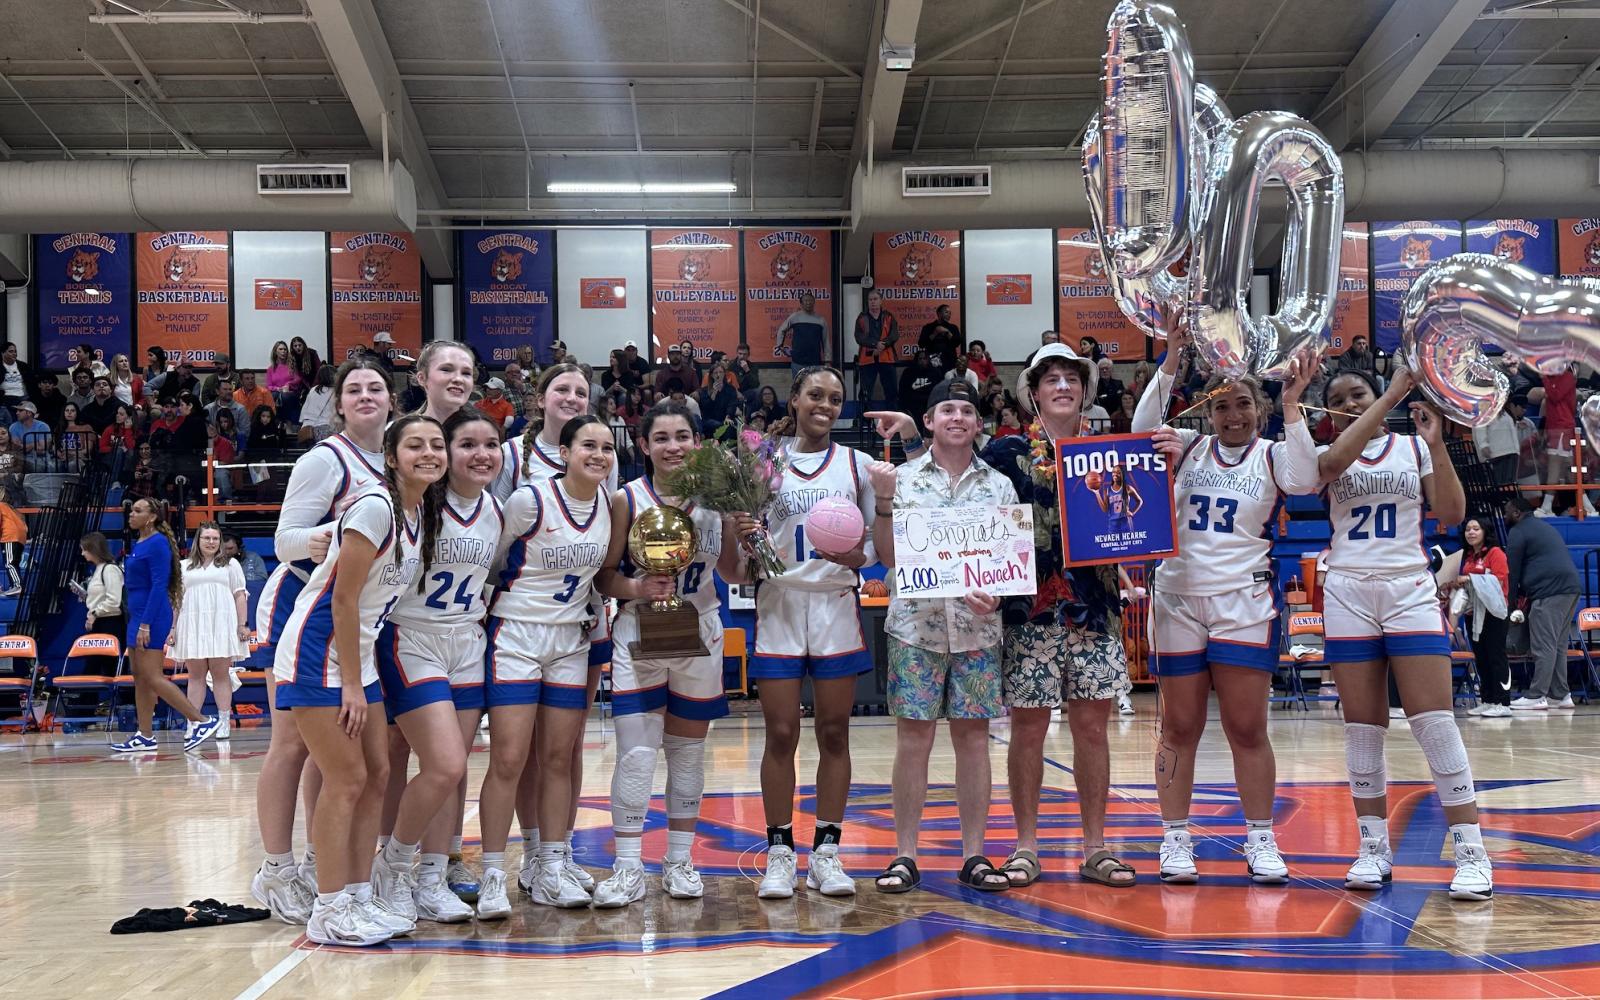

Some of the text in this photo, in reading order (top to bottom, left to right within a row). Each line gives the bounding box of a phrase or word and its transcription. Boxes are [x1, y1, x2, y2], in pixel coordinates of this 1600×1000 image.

[53, 233, 116, 254] CENTRAL
[345, 233, 406, 253] CENTRAL
[478, 233, 539, 254] CENTRAL
[759, 231, 817, 250] CENTRAL
[887, 231, 946, 249] CENTRAL
[1062, 285, 1114, 297] VOLLEY
[1375, 279, 1411, 292] CROSS
[58, 290, 112, 304] TENNIS
[138, 290, 228, 304] BASKETBALL
[333, 290, 421, 303] BASKETBALL
[470, 290, 548, 304] BASKETBALL
[655, 290, 737, 302] VOLLEYBALL
[878, 288, 958, 300] VOLLEYBALL
[51, 315, 93, 325] DISTRICT
[156, 313, 210, 322] BI-DISTRICT
[351, 312, 404, 321] BI-DISTRICT
[482, 316, 537, 324] BI-DISTRICT
[58, 326, 113, 335] RUNNER-UP
[165, 324, 202, 333] FINALIST
[359, 323, 395, 332] FINALIST
[1079, 321, 1126, 330] CHAMPION
[493, 348, 518, 361] 201
[692, 348, 713, 360] 012
[1099, 343, 1119, 354] 015
[163, 350, 215, 362] 017-2018
[1063, 450, 1167, 479] 1000 PTS
[1181, 469, 1263, 501] CENTRAL
[1331, 471, 1419, 504] CENTRAL
[1188, 494, 1238, 533] 33
[1348, 503, 1396, 540] 20
[906, 512, 1017, 552] Congrats
[1094, 531, 1147, 544] NEVAEH HEARNE
[795, 524, 823, 562] 1
[541, 540, 608, 570] CENTRA
[938, 551, 952, 560] on
[957, 548, 993, 558] reaching
[677, 562, 705, 595] 0
[898, 567, 938, 591] 1,000
[425, 571, 474, 611] 24
[553, 574, 581, 603] 3
[373, 596, 398, 628] 1
[1293, 618, 1323, 626] CENTRA
